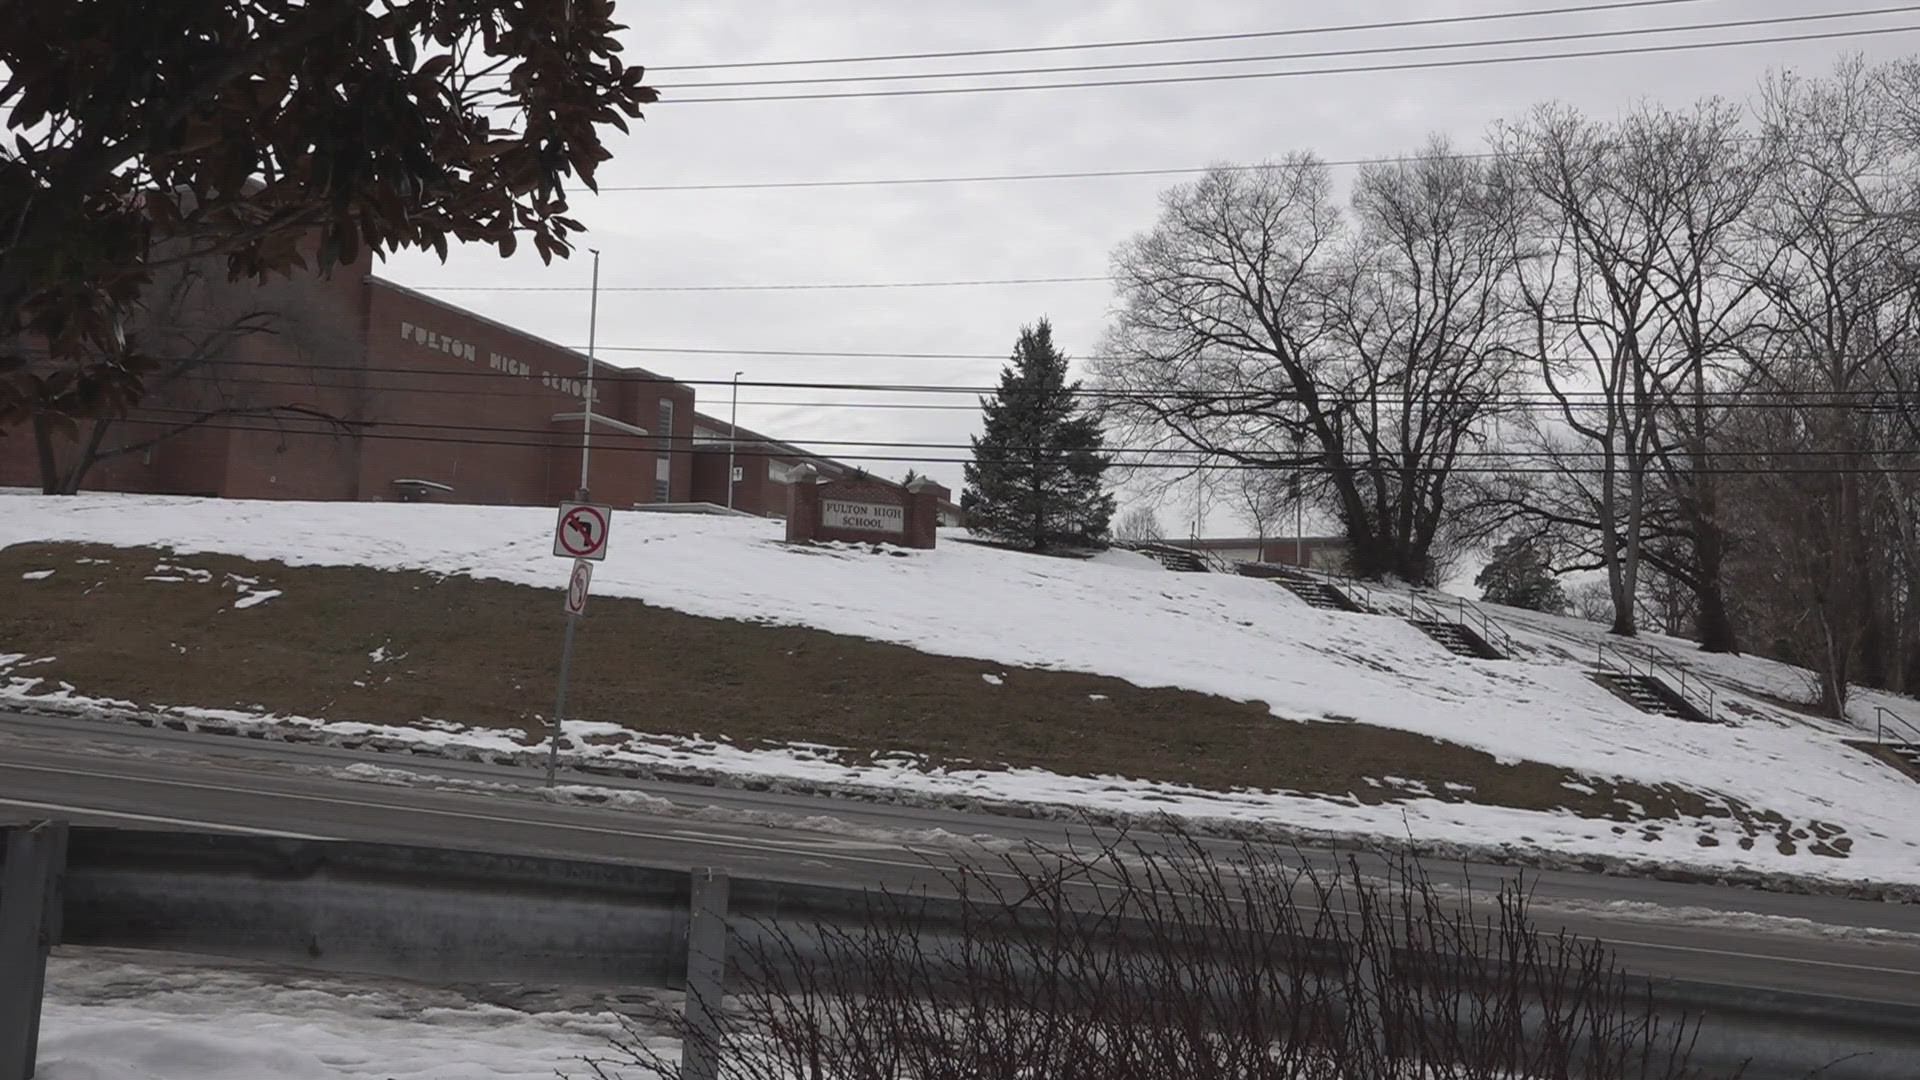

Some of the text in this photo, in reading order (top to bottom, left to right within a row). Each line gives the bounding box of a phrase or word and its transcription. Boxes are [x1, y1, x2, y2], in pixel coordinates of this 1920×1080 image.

[401, 322, 600, 403] FULTON HIGH SCHOOL
[826, 503, 902, 519] FULTON HIGH
[842, 516, 884, 529] SCHOOL
